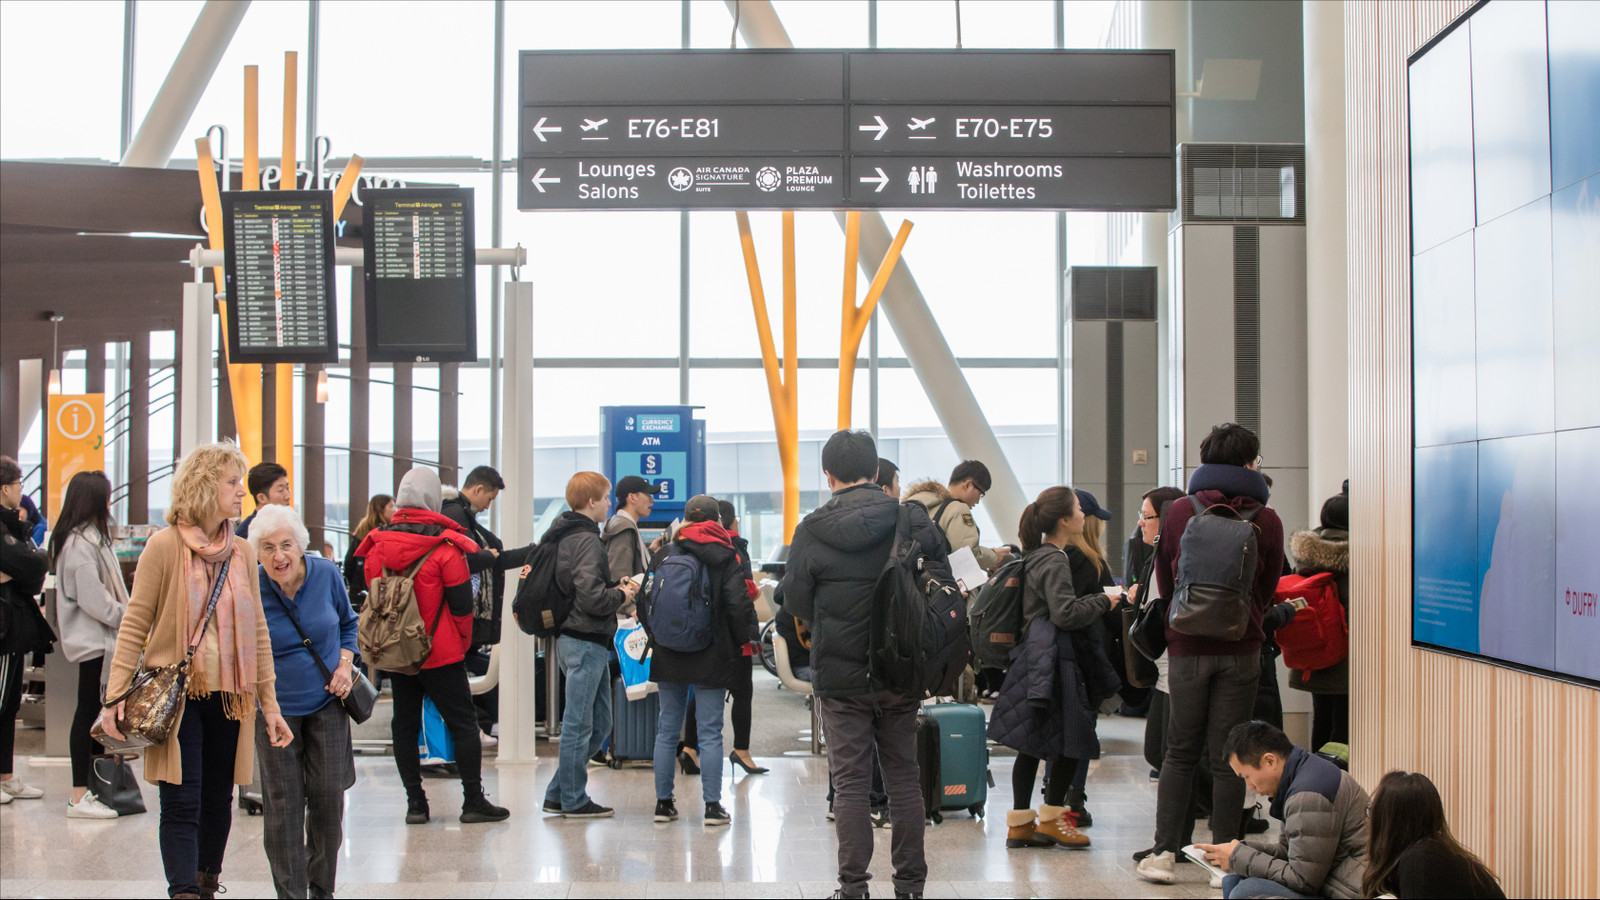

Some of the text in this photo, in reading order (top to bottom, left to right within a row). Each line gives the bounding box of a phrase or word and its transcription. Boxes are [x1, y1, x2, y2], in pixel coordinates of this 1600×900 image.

[628, 118, 719, 138] E76-E81
[955, 118, 1053, 138] E70-E75
[578, 161, 656, 180] Lounges
[695, 173, 744, 181] SIGNATURE
[786, 166, 820, 175] PLAZA
[956, 161, 1063, 178] Washrooms
[786, 175, 833, 184] PREMIUM
[578, 183, 639, 199] Salons
[957, 183, 1036, 199] Toilettes
[642, 437, 660, 446] ATM
[1572, 591, 1598, 616] DUFRY
